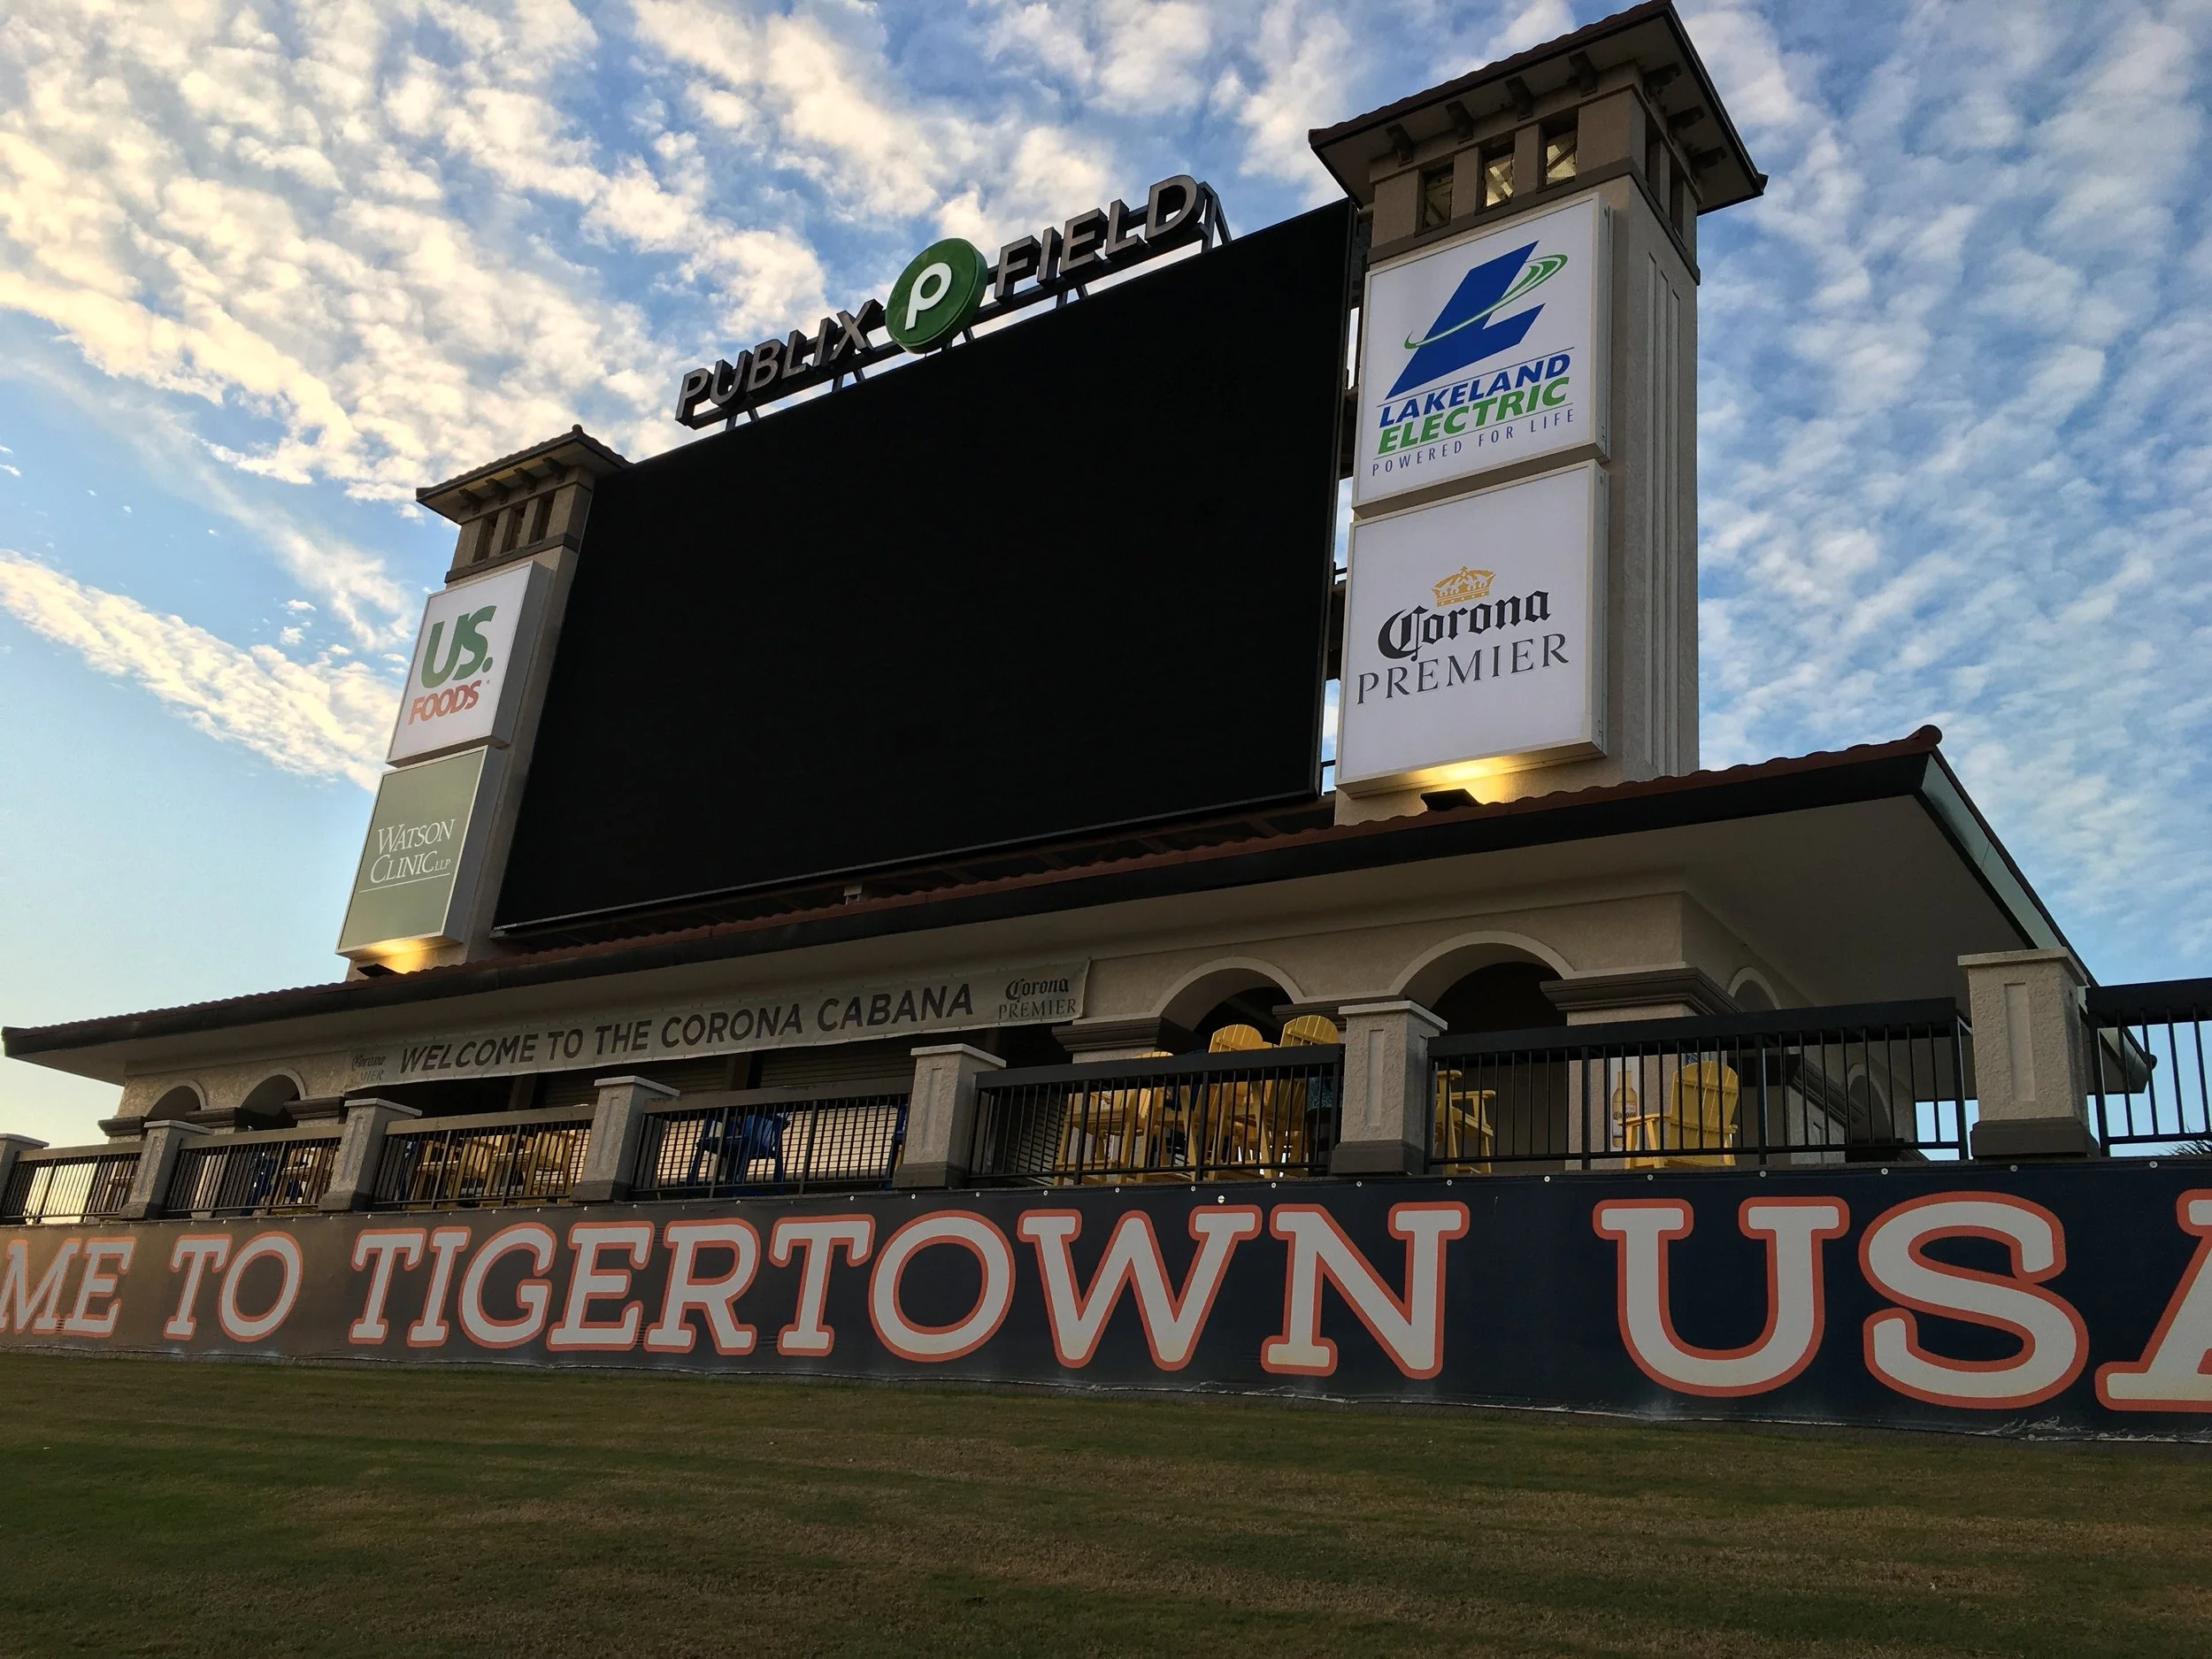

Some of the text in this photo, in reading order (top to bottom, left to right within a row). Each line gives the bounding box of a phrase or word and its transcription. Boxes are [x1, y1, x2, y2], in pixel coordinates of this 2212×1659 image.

[675, 298, 885, 428] PUBLIX
[995, 174, 1206, 303] FIELD
[1378, 377, 1570, 455] ELECTRIC
[1379, 353, 1571, 428] LAKELAND
[1371, 409, 1573, 476] POWERED FOR LIFE
[1378, 589, 1551, 662] Corona
[408, 680, 482, 725] FOODS
[1356, 633, 1570, 705] PREMIER
[998, 998, 1076, 1019] PREMIER
[1005, 977, 1070, 1002] Corona
[399, 983, 974, 1074] WELCOME TO THE CORONA CABANA
[164, 1231, 303, 1342] TO
[349, 1202, 1471, 1380] TIGERTOWN
